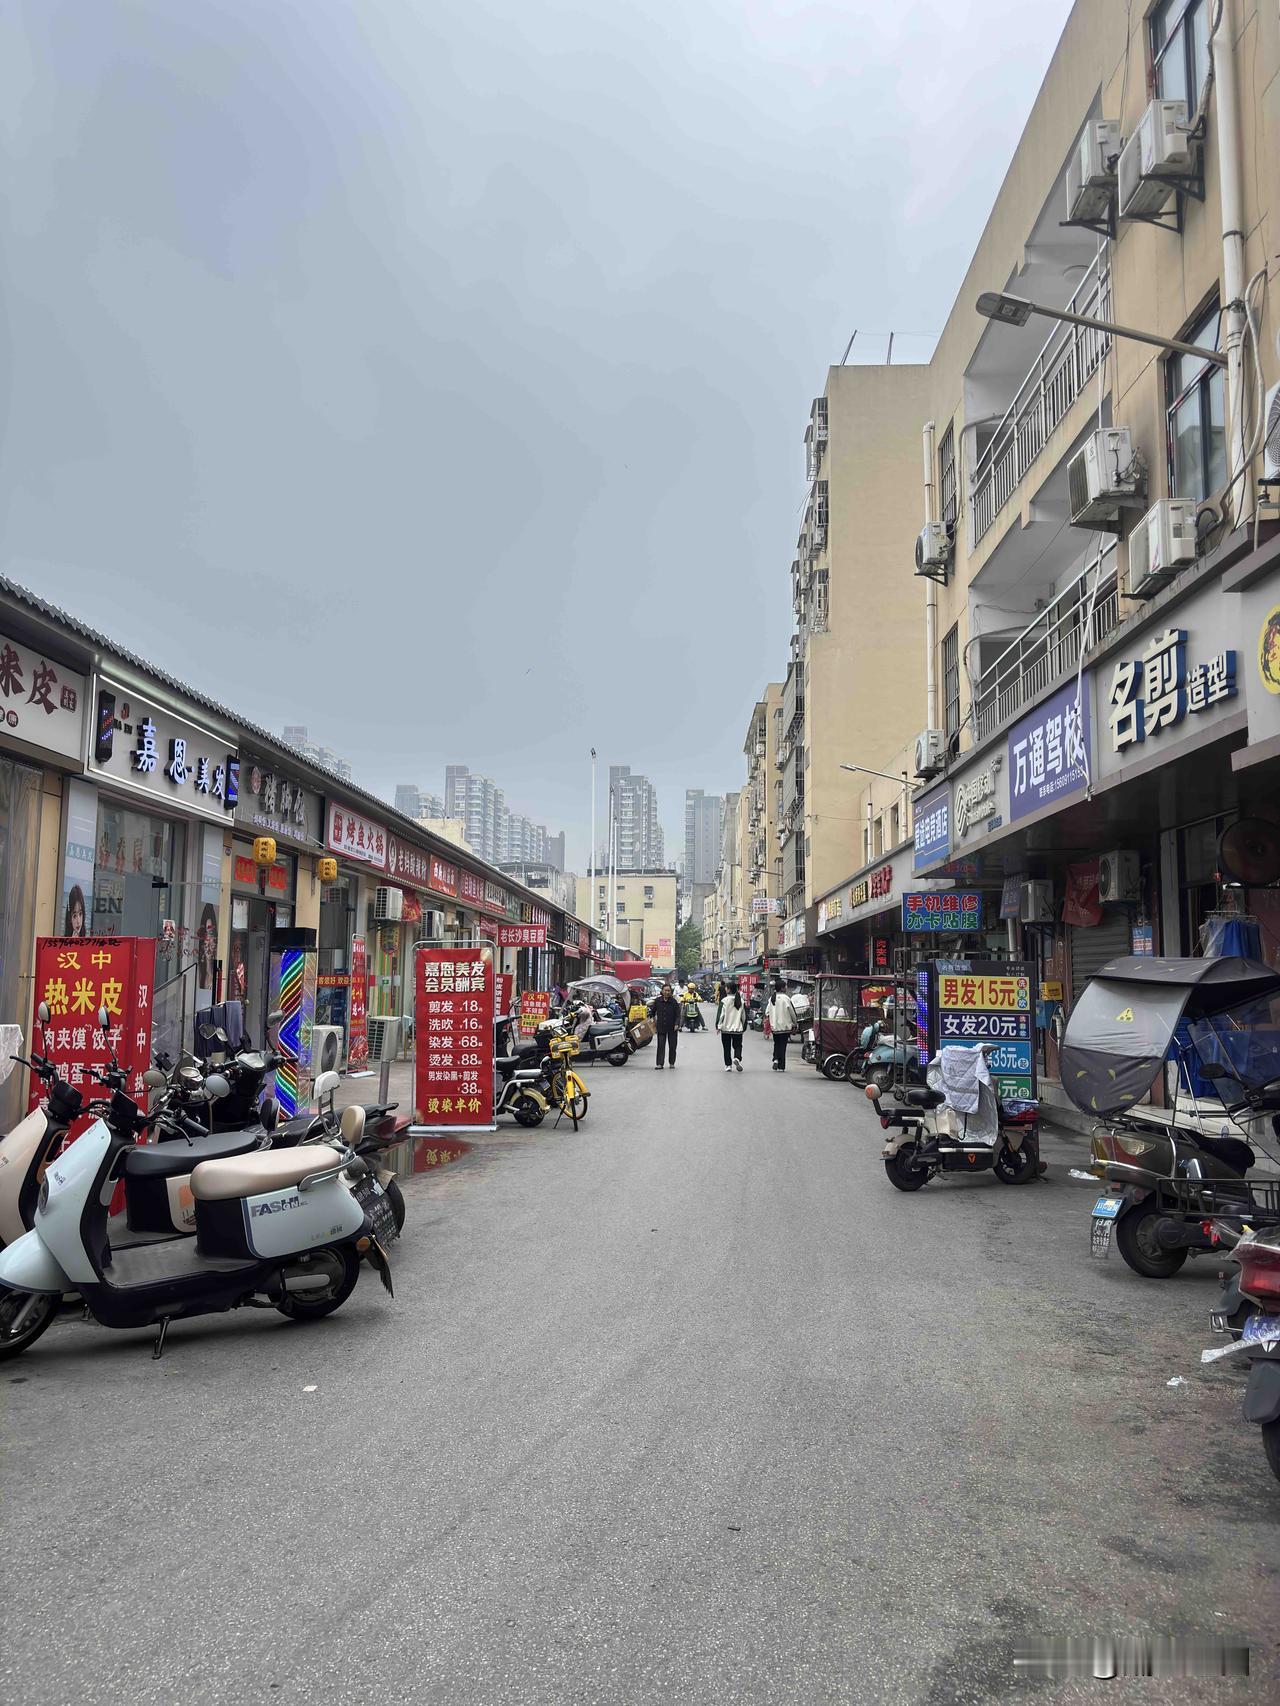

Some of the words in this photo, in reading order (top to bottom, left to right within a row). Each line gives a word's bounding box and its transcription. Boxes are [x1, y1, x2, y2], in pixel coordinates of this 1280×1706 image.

[1109, 629, 1235, 752] 名剪造型
[133, 717, 225, 800] 嘉恩美发
[1014, 705, 1083, 797] 万通驾校
[907, 895, 978, 911] 手机维修
[907, 913, 978, 929] 办卡贴膜
[501, 928, 545, 943] 老长沙臭豆腐
[57, 951, 112, 970] 汉中
[425, 961, 485, 977] 嘉恩美发
[425, 978, 485, 993] 会员酬宾
[944, 979, 1016, 1007] 男发15元
[45, 977, 123, 1015] 热米皮
[429, 1001, 453, 1013] 剪发
[429, 1018, 453, 1031] 洗吹
[944, 1014, 1017, 1037] 女发20元
[429, 1036, 453, 1048] 染发
[429, 1054, 453, 1066] 烫发
[428, 1097, 482, 1113] 烫染半价
